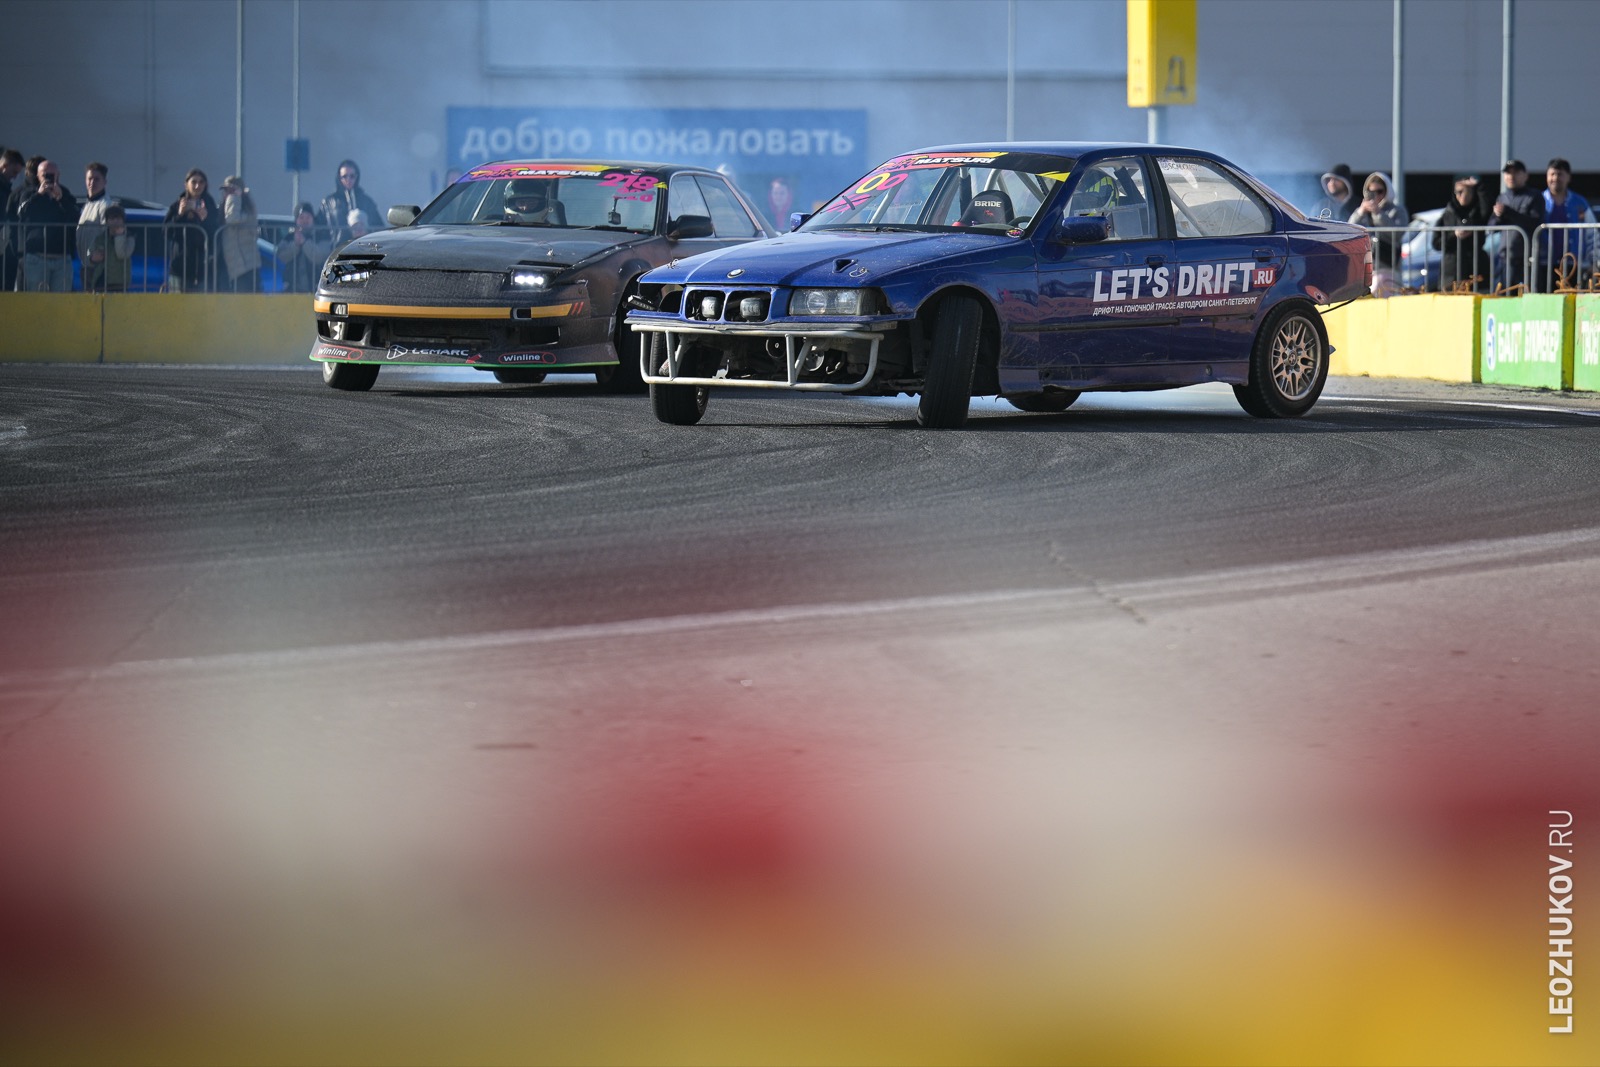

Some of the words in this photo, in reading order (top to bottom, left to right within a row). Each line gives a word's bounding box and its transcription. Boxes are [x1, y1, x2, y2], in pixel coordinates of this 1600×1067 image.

[460, 118, 592, 158] добро
[604, 125, 853, 156] пожаловать
[596, 173, 659, 190] 218
[974, 200, 1002, 208] BRIDE
[1092, 266, 1170, 303] LET'S
[1092, 306, 1115, 317] ДРИФТ
[1115, 305, 1123, 314] НА
[1123, 302, 1155, 313] ГОНОЧНОЙ
[1155, 301, 1176, 311] ТРАССЕ
[1176, 299, 1208, 310] АВТОДРОМ
[1208, 296, 1258, 308] САНКТ-ПЕТЕРБУРГ
[317, 347, 348, 357] Winline
[411, 348, 470, 357] LEMARC
[503, 353, 541, 362] Winline
